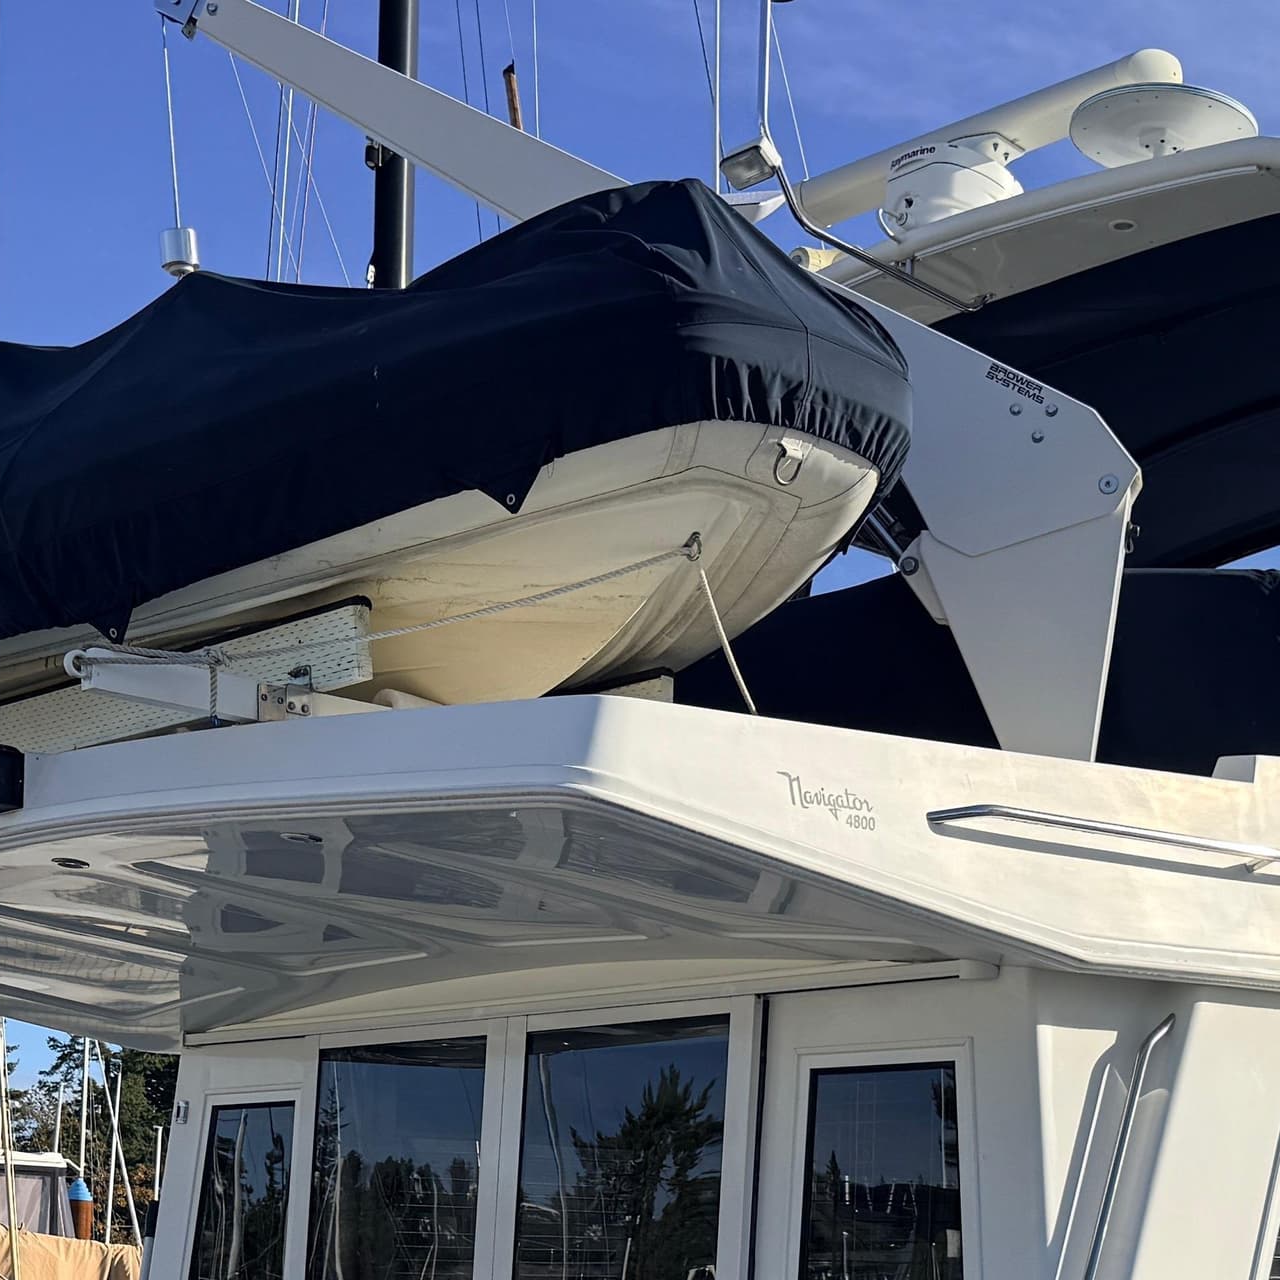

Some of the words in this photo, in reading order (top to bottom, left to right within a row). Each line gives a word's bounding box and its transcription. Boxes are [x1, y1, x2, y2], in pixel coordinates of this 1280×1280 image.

[985, 370, 1045, 405] SYSTEMS
[990, 362, 1043, 395] BROWER
[776, 771, 874, 821] Navigator
[846, 812, 876, 832] 4800
